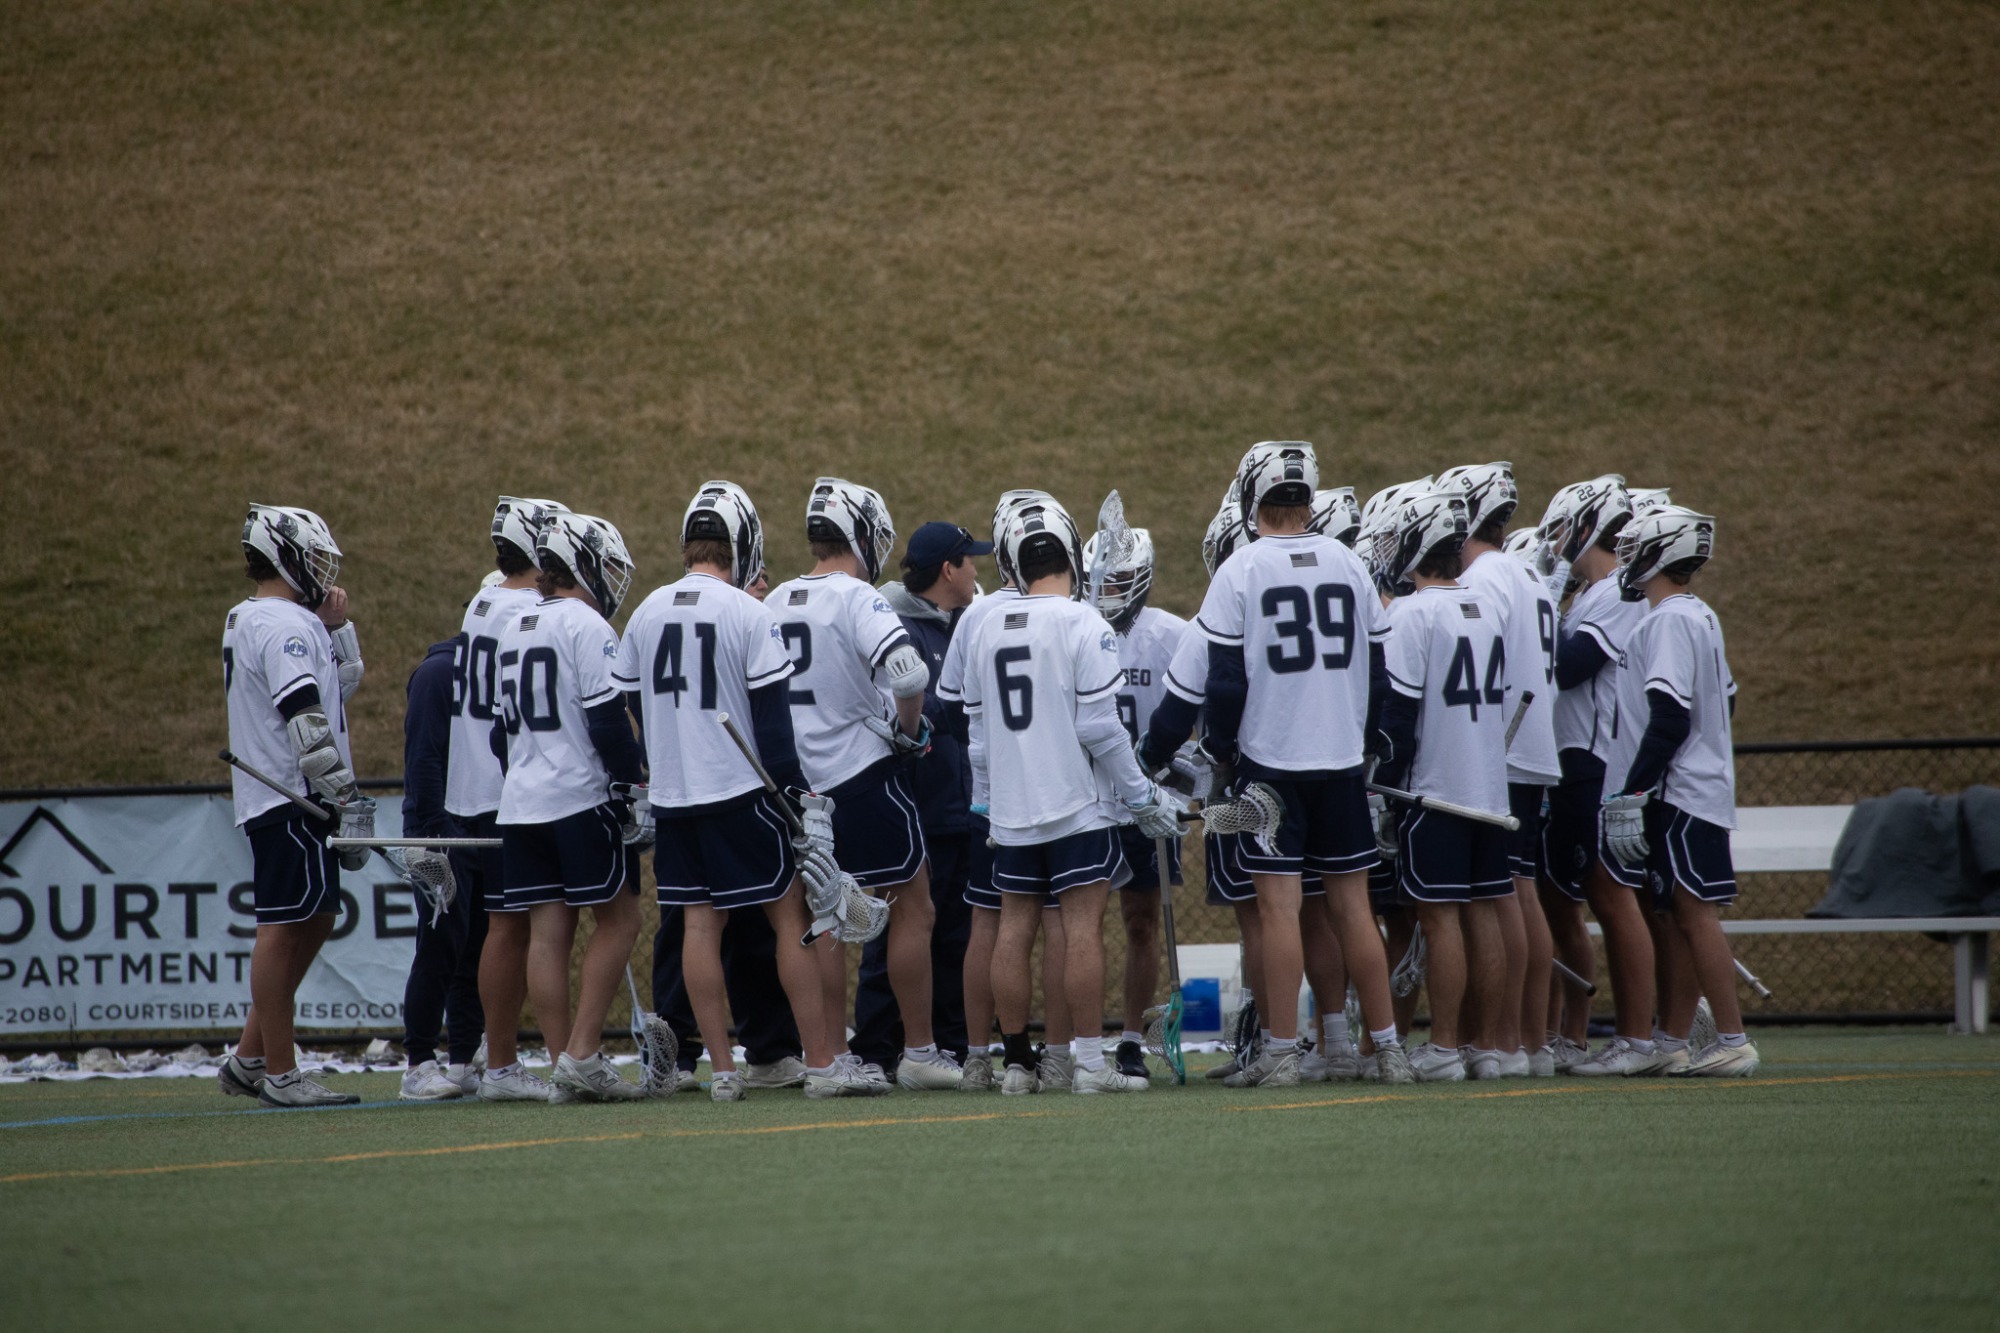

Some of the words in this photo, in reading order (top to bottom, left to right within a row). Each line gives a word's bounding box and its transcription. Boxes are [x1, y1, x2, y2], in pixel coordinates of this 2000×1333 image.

[1220, 512, 1233, 532] 35
[1403, 505, 1419, 523] 44
[1577, 484, 1596, 502] 22
[653, 622, 717, 710] 41
[1261, 582, 1356, 674] 39
[994, 645, 1033, 732] 6
[1442, 635, 1505, 722] 44
